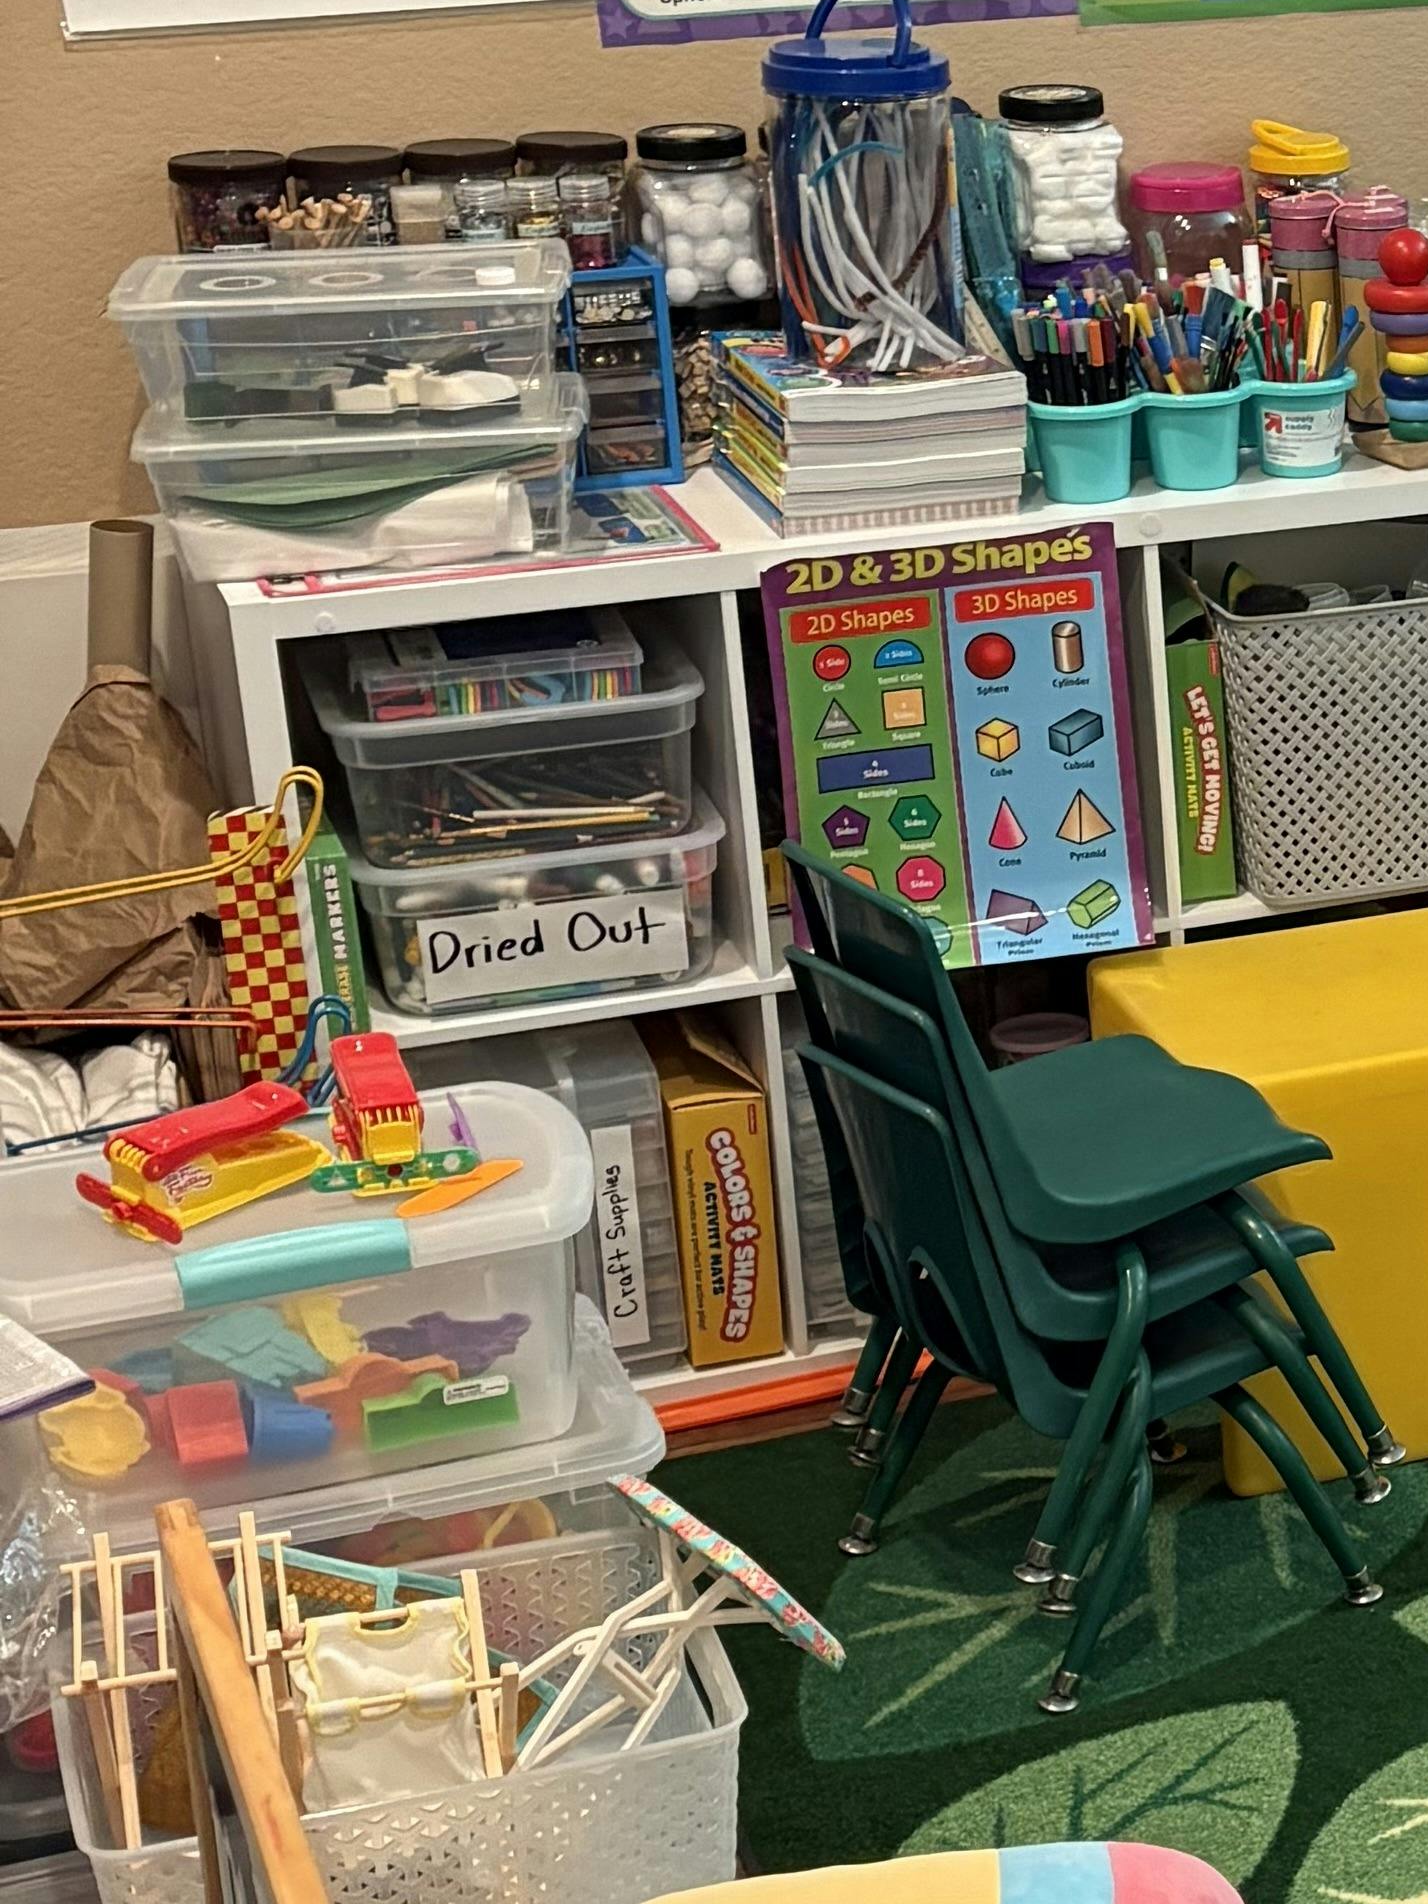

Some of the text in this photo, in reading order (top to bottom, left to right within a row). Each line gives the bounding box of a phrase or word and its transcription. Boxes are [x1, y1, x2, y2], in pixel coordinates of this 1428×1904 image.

[786, 534, 1091, 593] 2D & 3D Shapes
[807, 606, 913, 634] 2D Shapes
[971, 586, 1077, 613] 3D Shapes
[323, 863, 347, 960] MARKERS
[428, 906, 666, 975] Dried Out
[601, 1164, 639, 1318] Craft Supplies
[709, 1130, 756, 1339] COLORS SHAPES
